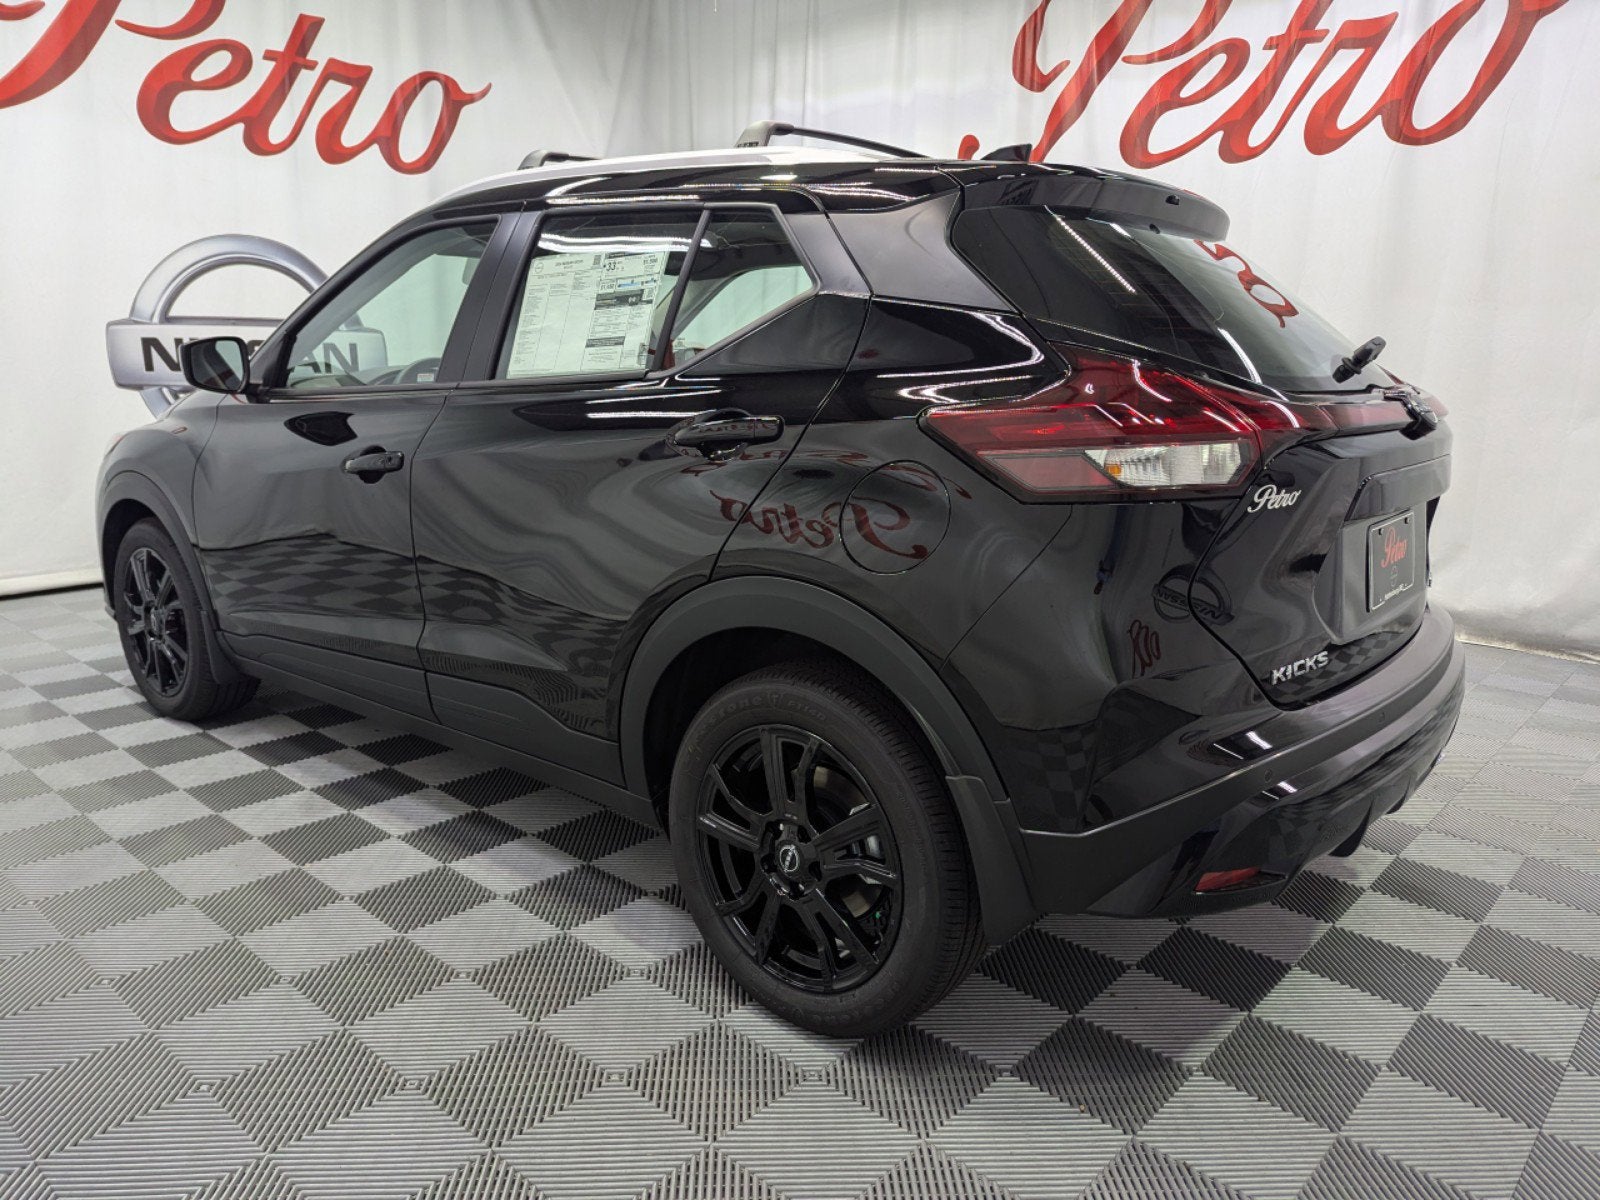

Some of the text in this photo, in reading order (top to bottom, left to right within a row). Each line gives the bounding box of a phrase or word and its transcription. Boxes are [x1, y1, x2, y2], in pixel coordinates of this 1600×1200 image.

[141, 337, 359, 374] NAN
[1247, 484, 1302, 513] Petro
[1271, 651, 1329, 685] KICKS
